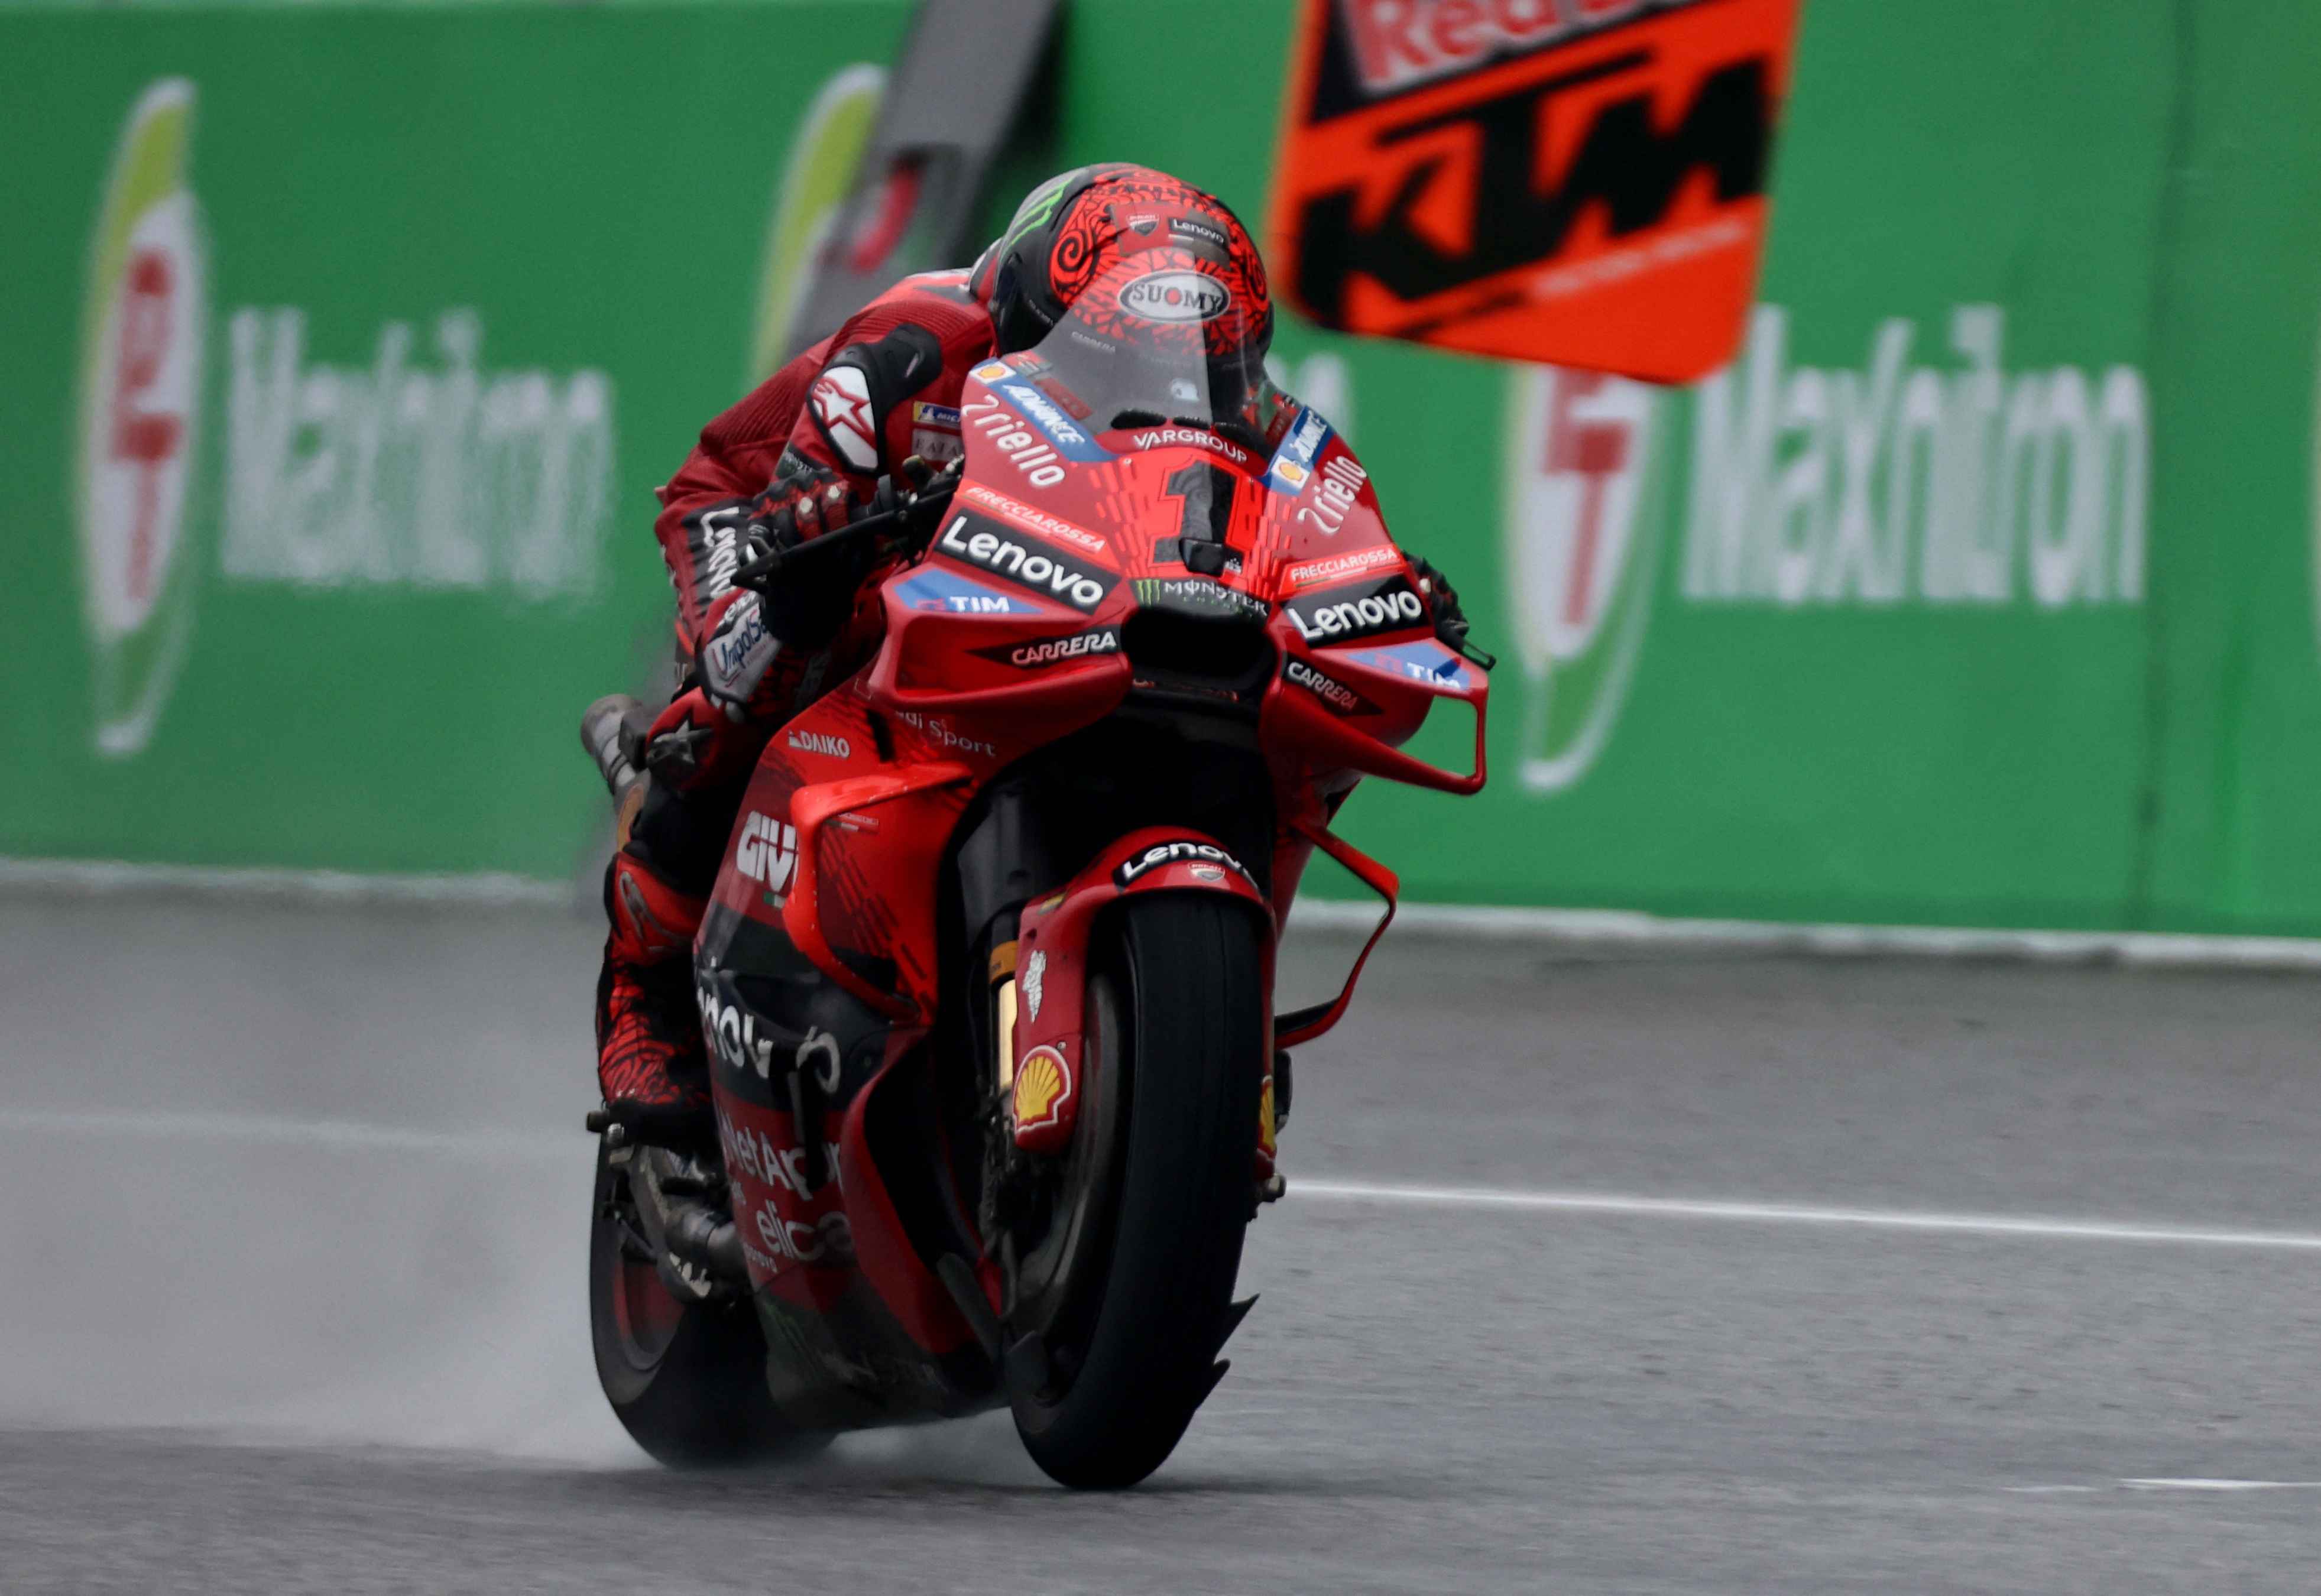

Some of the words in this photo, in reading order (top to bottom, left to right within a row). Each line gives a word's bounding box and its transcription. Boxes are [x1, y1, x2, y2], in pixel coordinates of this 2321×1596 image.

[1295, 44, 1768, 331] KTM
[1172, 218, 1225, 244] Lenovo
[1130, 282, 1224, 312] SUOMY
[1133, 429, 1248, 463] VARGROUP
[966, 486, 1107, 552] FRECCIAROSSA
[1153, 459, 1245, 573] 1
[941, 515, 1104, 604] Lenovo
[1291, 547, 1398, 581] FRECCIAROSSA
[949, 595, 1010, 613] TIM
[1288, 591, 1422, 640] Lenovo
[1012, 631, 1116, 666] CARRERA
[1287, 660, 1358, 711] CARRERA
[799, 731, 850, 758] DAIKO
[929, 719, 997, 757] Sport
[735, 810, 799, 893] GIV
